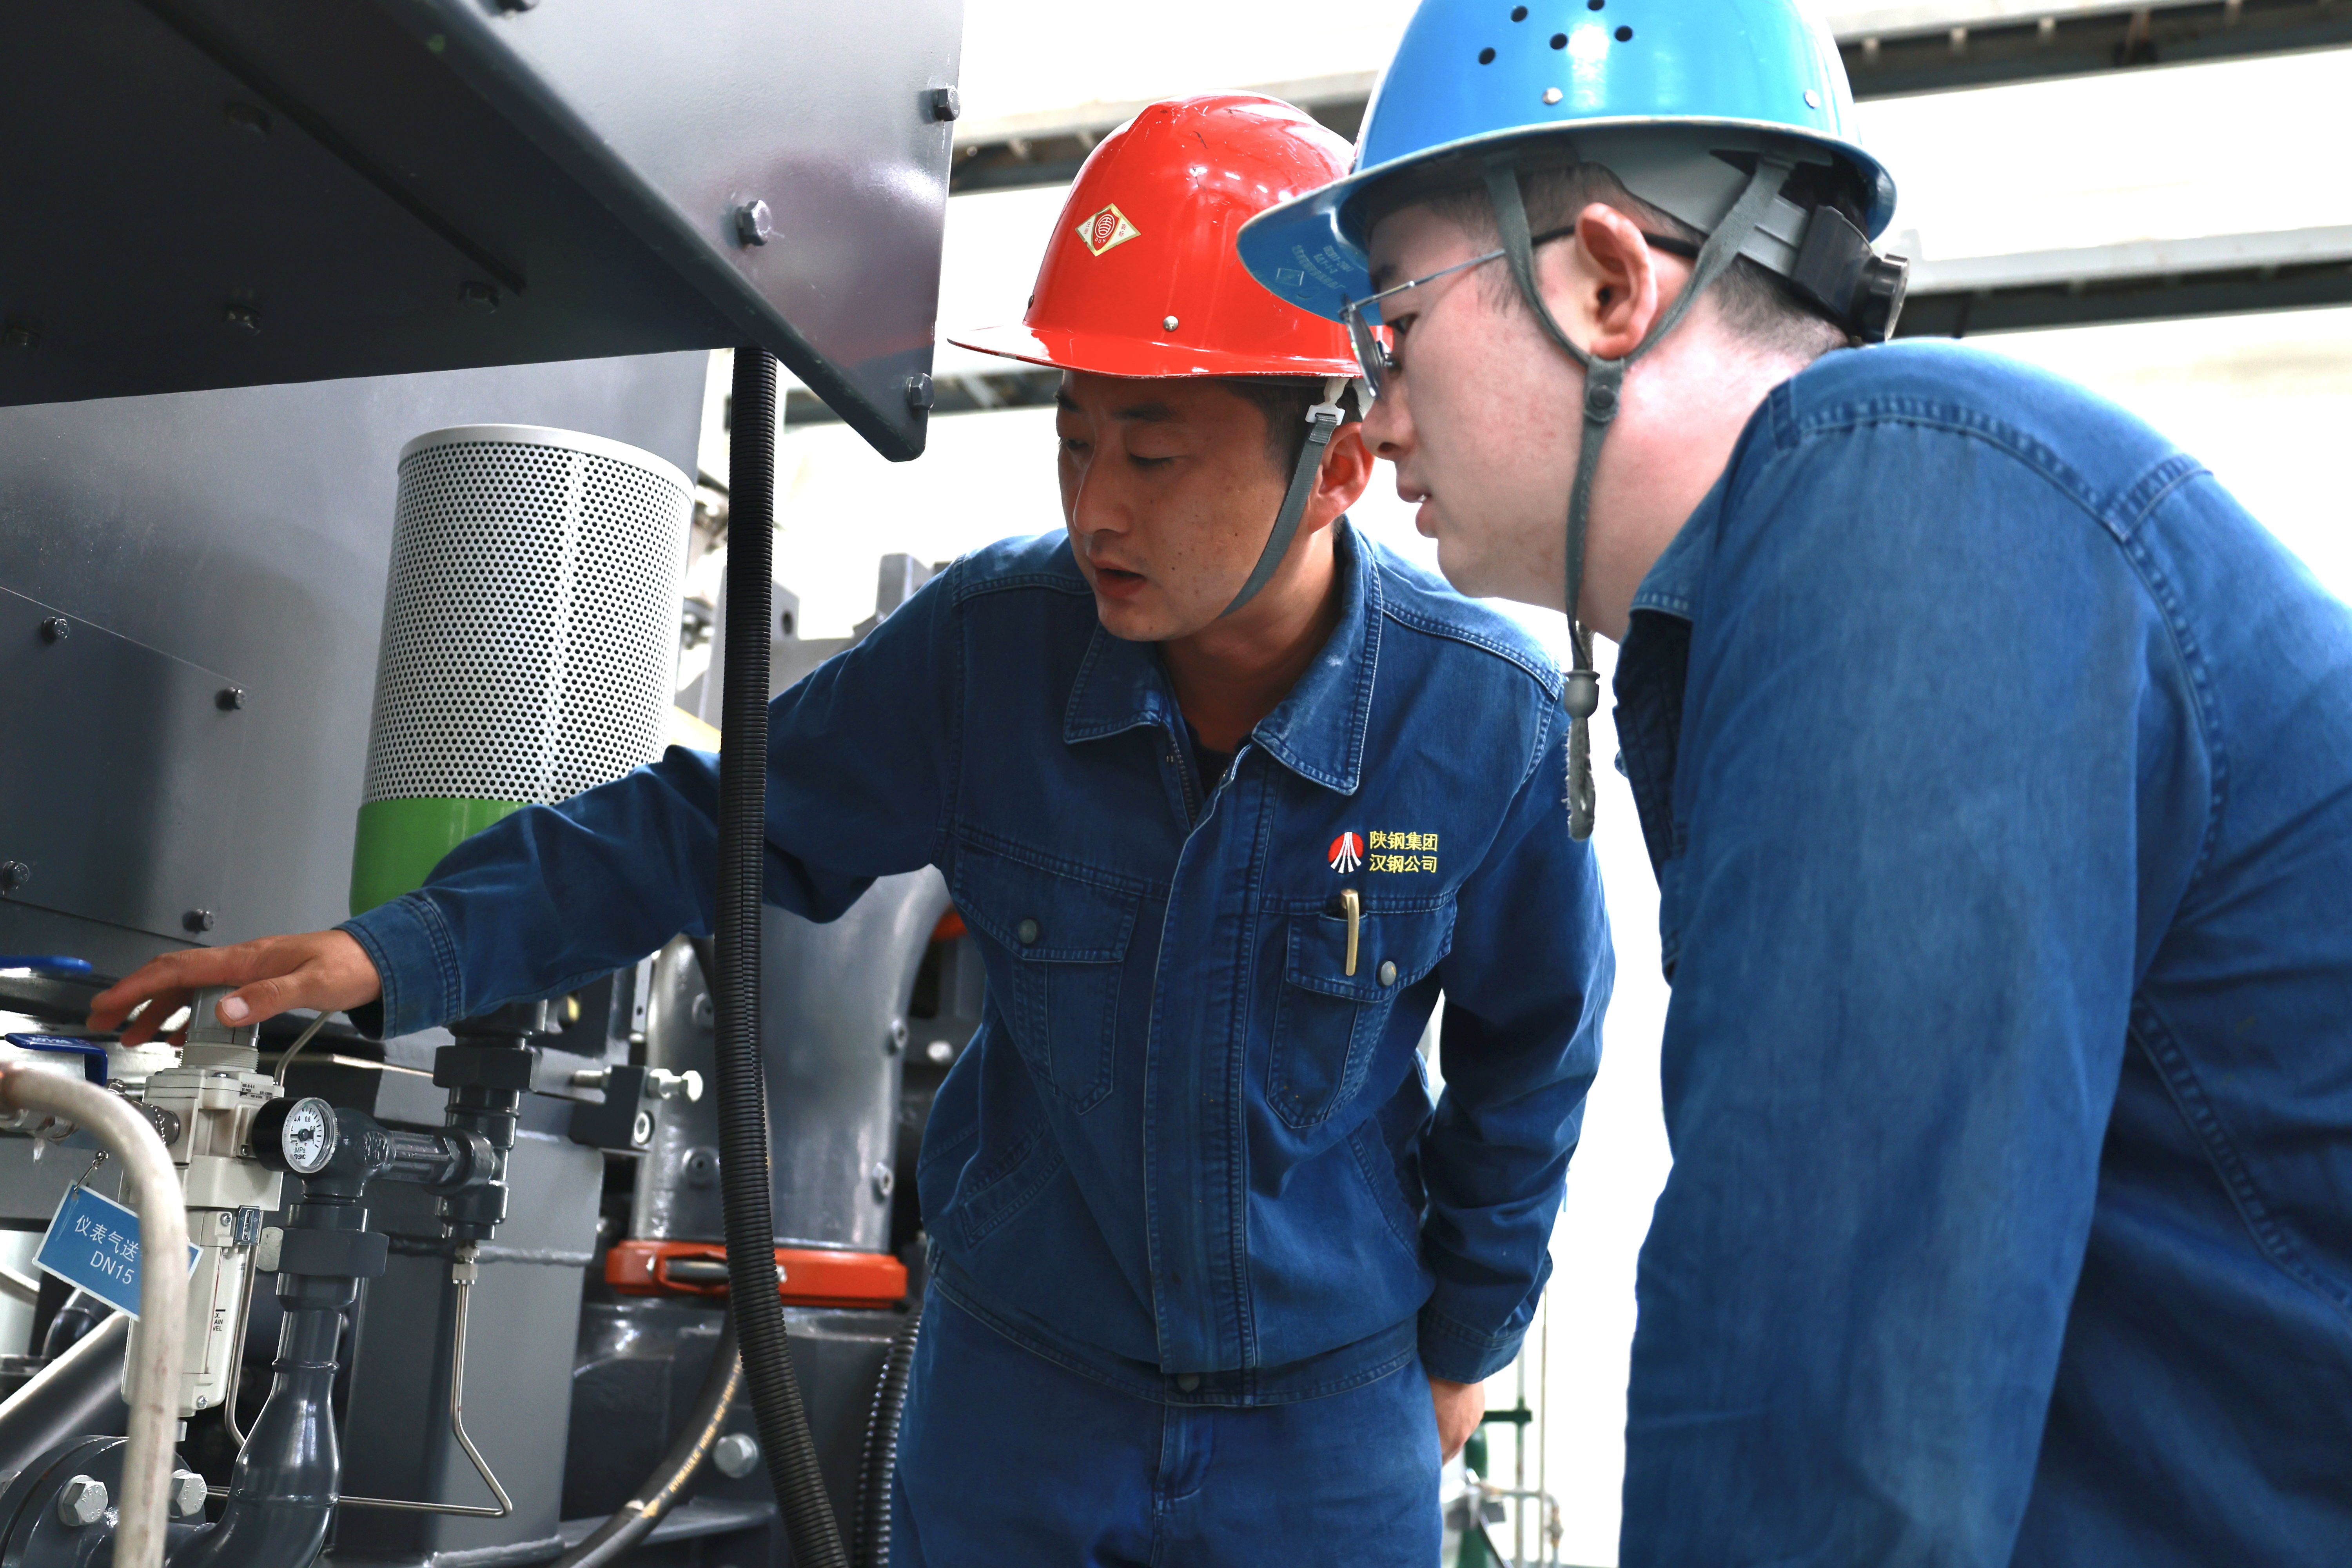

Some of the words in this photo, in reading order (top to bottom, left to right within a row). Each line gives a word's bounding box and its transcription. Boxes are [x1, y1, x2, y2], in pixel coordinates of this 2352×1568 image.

[1369, 830, 1438, 851] 陕钢集团
[1369, 853, 1437, 873] 汉钢公司
[74, 1214, 139, 1262] 仪表气送
[90, 1250, 134, 1284] DN15
